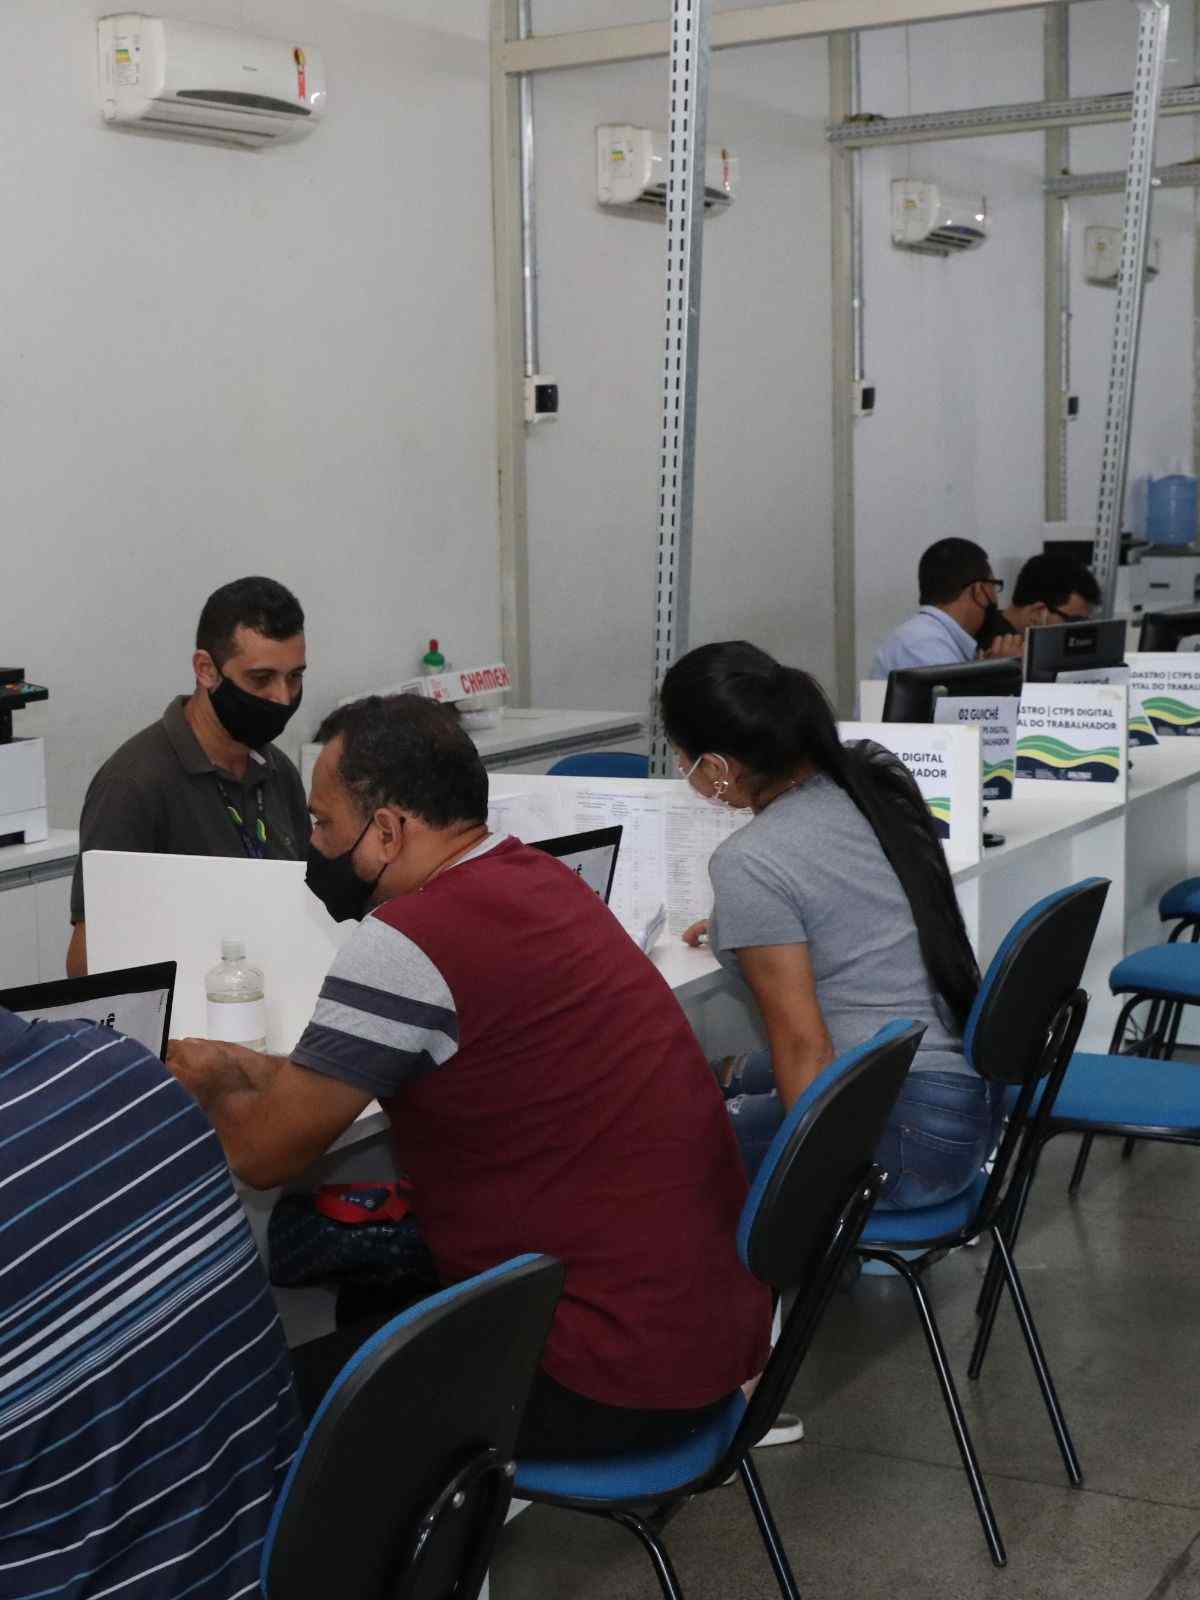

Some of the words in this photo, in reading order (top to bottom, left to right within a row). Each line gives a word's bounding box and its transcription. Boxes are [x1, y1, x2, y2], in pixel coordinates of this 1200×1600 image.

[1076, 708, 1114, 718] DIGITAL
[1046, 720, 1117, 730] TRABALHADOR
[902, 752, 945, 763] DIGITAL
